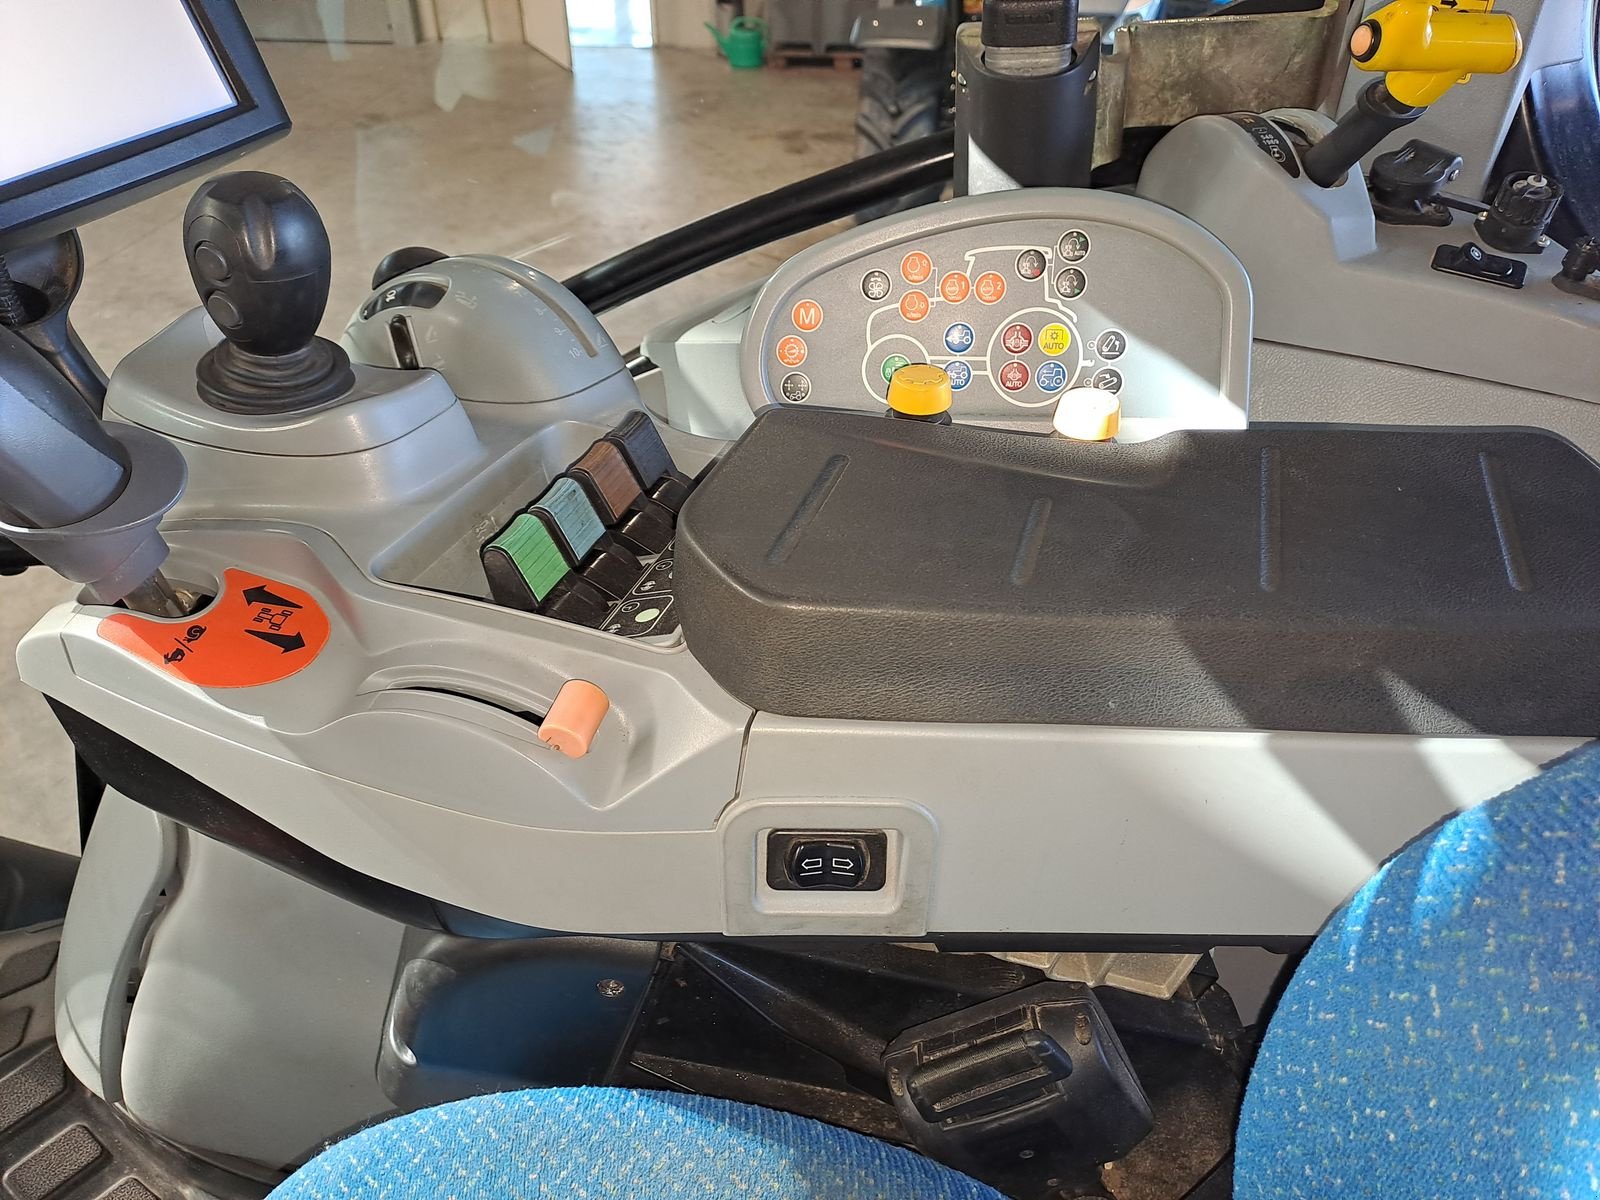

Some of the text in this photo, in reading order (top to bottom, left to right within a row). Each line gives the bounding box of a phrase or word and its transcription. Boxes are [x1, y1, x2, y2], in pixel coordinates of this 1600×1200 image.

[961, 281, 965, 289] 1
[997, 282, 1002, 290] 2
[800, 307, 815, 325] M
[1043, 342, 1064, 350] AUTO
[1005, 380, 1022, 388] AUTO
